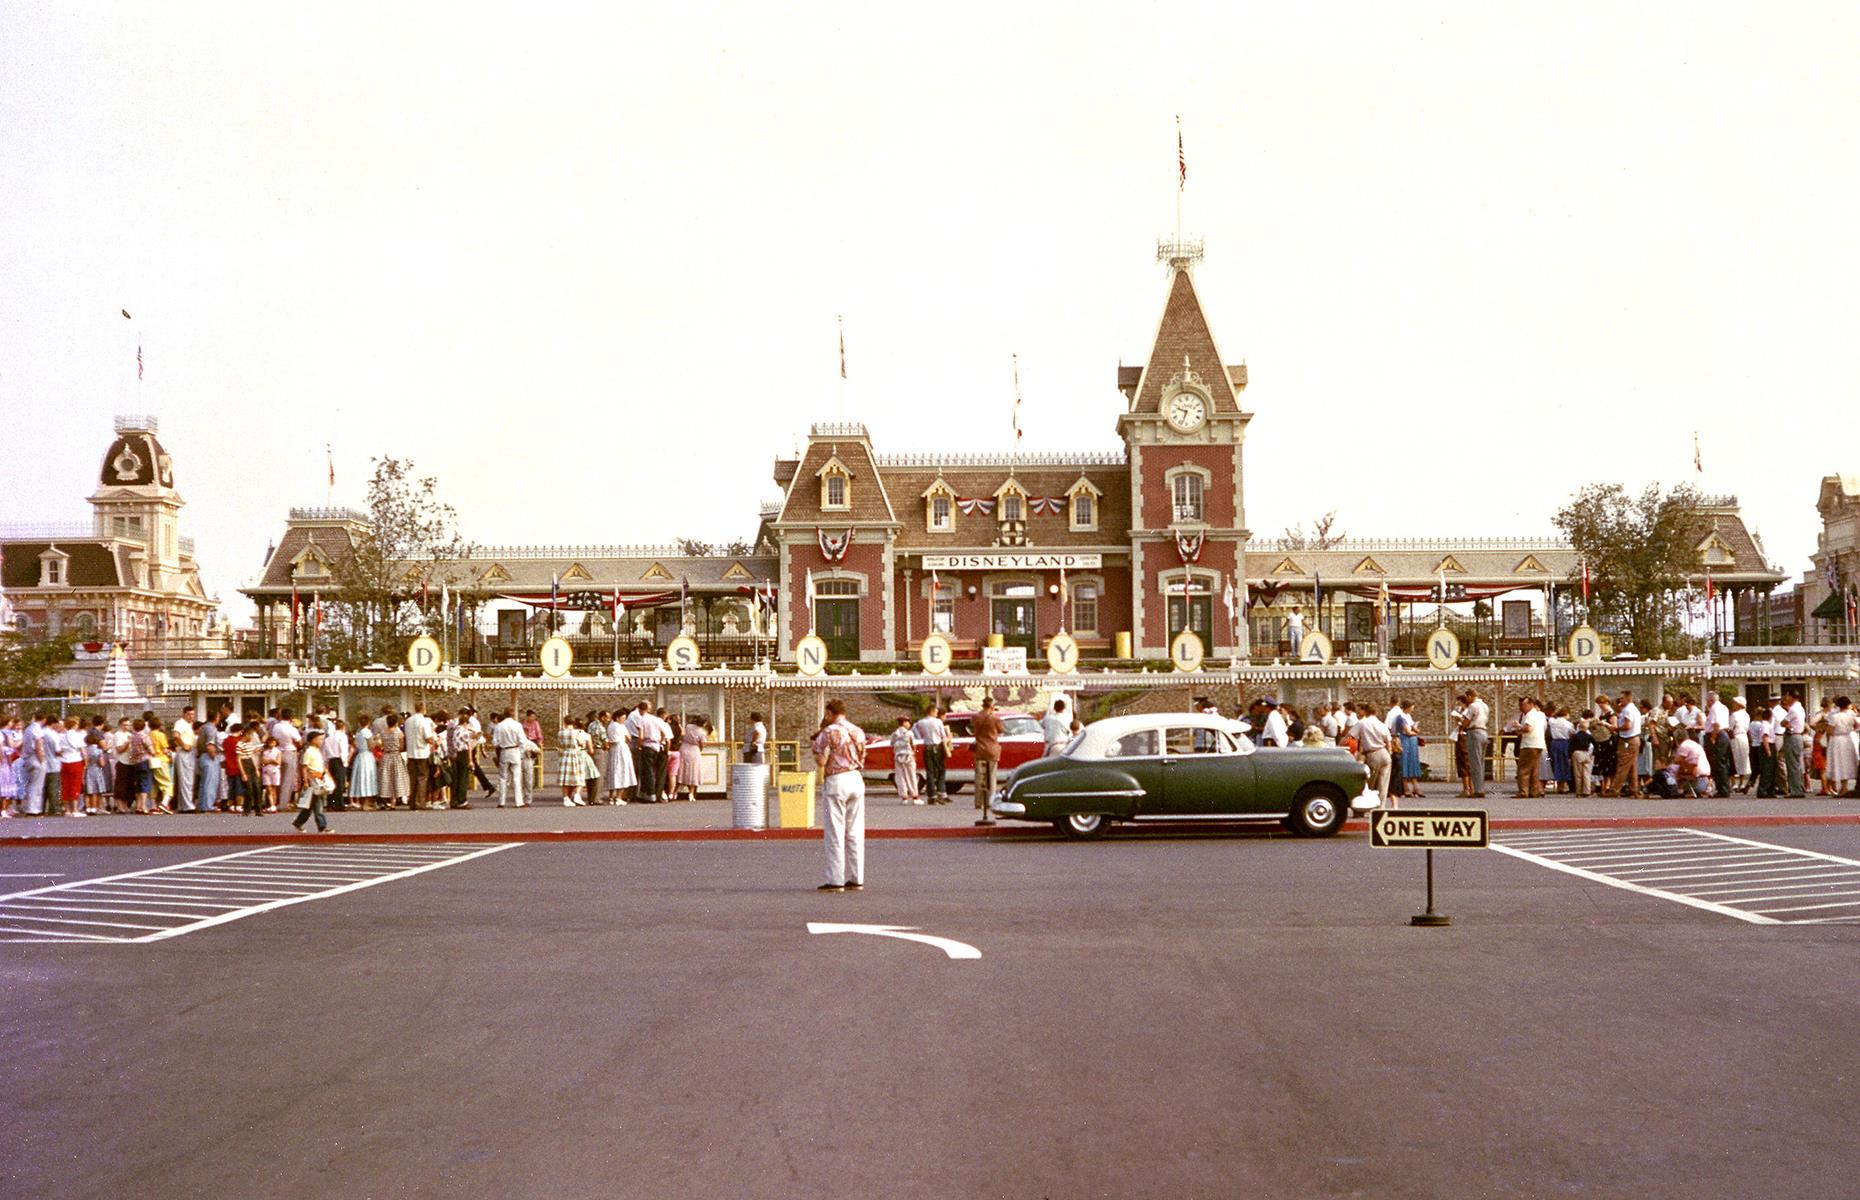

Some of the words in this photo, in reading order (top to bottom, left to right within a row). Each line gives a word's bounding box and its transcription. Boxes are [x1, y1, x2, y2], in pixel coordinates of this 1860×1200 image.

[950, 556, 1075, 567] DISNEYLAND
[416, 648, 433, 666] D
[676, 647, 691, 666] S
[804, 647, 819, 665] N
[930, 645, 942, 663] E
[1055, 644, 1071, 662] Y
[1181, 643, 1193, 661] L
[1308, 642, 1323, 659] A
[1434, 640, 1451, 659] N
[1577, 638, 1593, 656] D
[781, 783, 806, 793] WASTE
[1383, 821, 1424, 836] ONE
[1432, 821, 1475, 836] WAY
